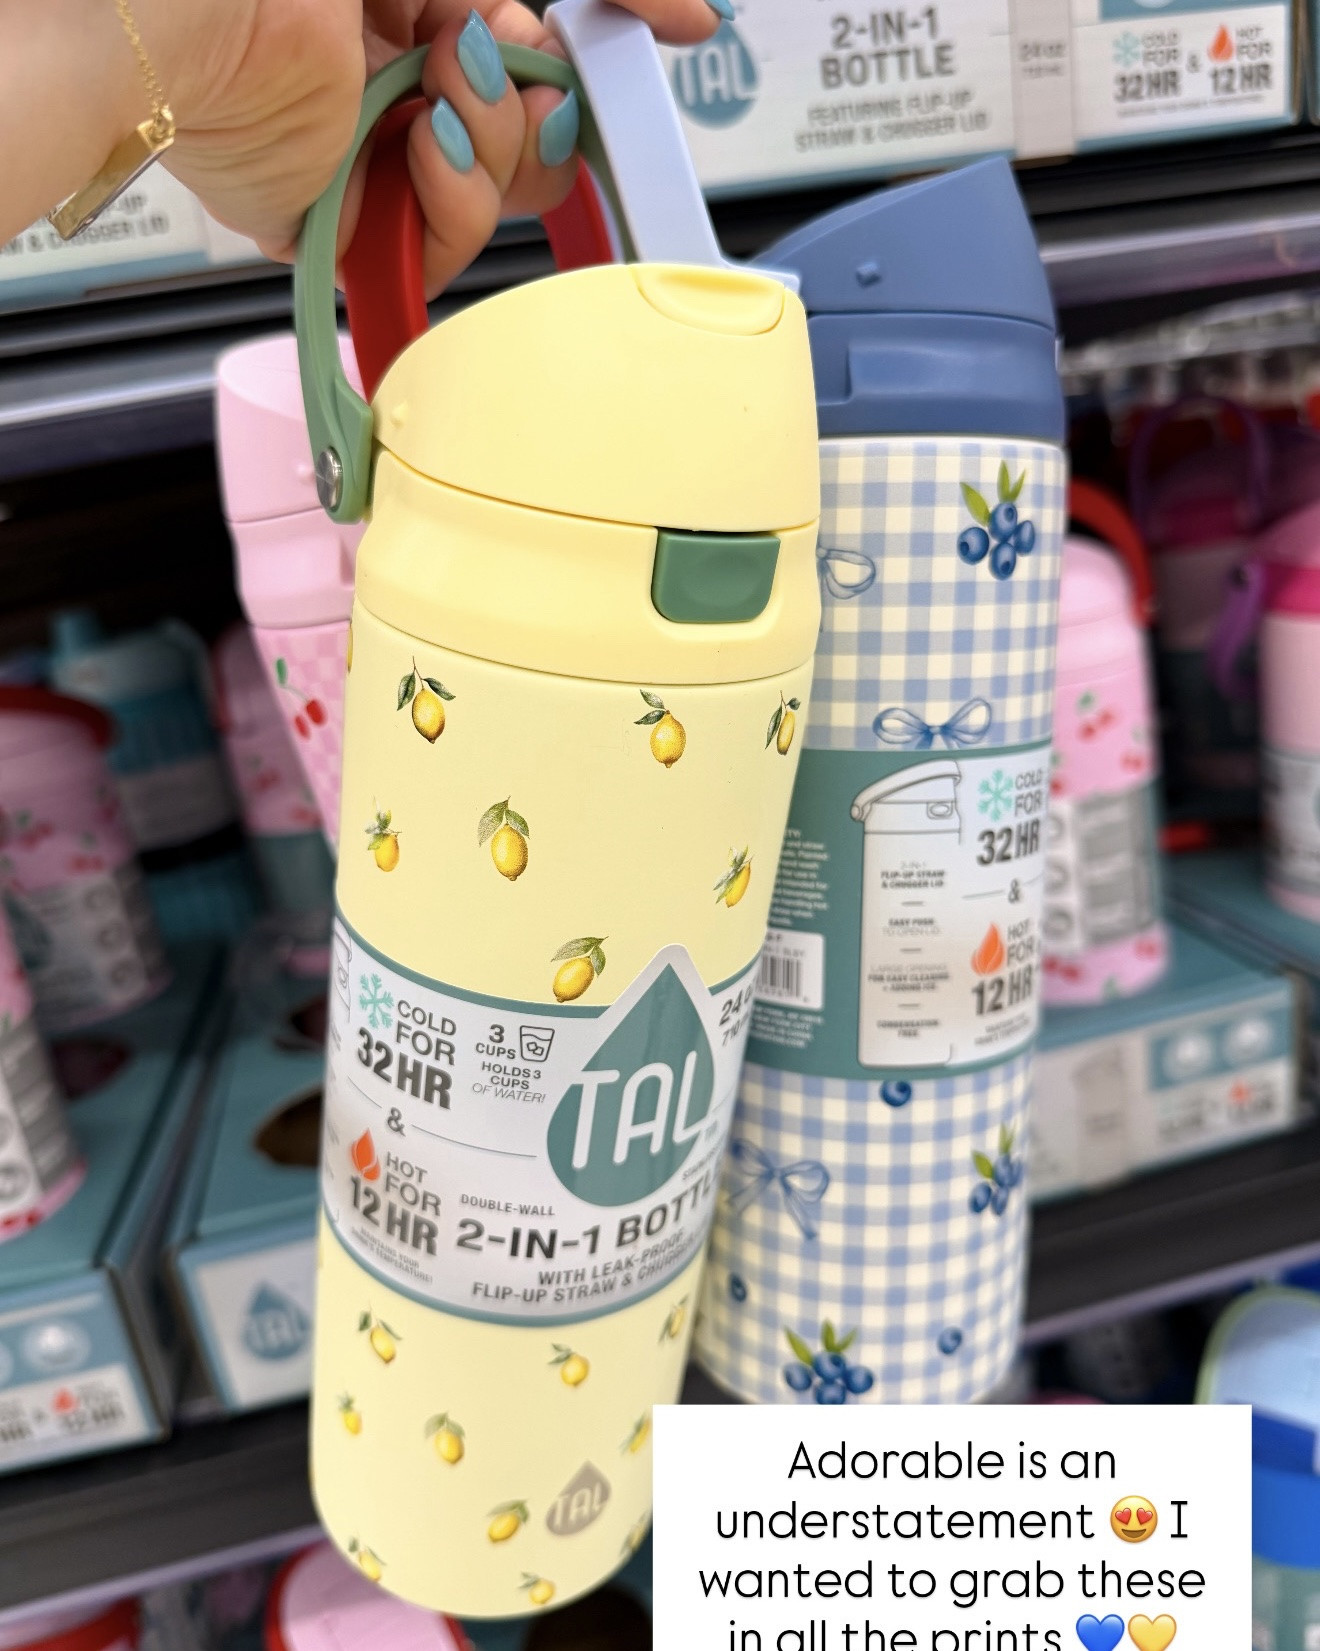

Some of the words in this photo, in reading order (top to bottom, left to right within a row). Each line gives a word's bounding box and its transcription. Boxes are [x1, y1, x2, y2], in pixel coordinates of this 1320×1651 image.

[831, 7, 940, 50] 2-IN-1
[1142, 30, 1181, 49] COLD
[819, 42, 956, 90] BOTTLE
[1143, 48, 1181, 69] FOR
[1236, 41, 1274, 63] FOR
[671, 41, 757, 107] TAL
[1113, 73, 1144, 103] 32
[1145, 68, 1182, 101] HR
[1209, 66, 1236, 96] 12
[1239, 62, 1273, 93] HR
[1014, 769, 1042, 791] COLD
[1014, 790, 1042, 817] FOR
[976, 827, 1012, 866] 32
[1014, 818, 1040, 860] HR
[1008, 879, 1020, 903] &
[1007, 918, 1029, 940] HOT
[1007, 936, 1034, 967] FOR
[971, 977, 1005, 1016] 12
[1007, 964, 1032, 1006] HR
[397, 999, 457, 1037] COLD
[719, 989, 742, 1027] 24
[396, 1020, 456, 1066] FOR
[489, 1024, 505, 1043] 3
[475, 1042, 516, 1060] CUPS
[357, 1027, 394, 1084] 32
[396, 1051, 453, 1110] HR
[481, 1061, 531, 1079] HOLDS
[533, 1069, 542, 1080] 3
[490, 1075, 530, 1090] CUPS
[472, 1082, 493, 1096] OF
[494, 1084, 548, 1104] WATER!
[568, 1049, 710, 1170] TAL
[386, 1106, 406, 1137] &
[386, 1151, 428, 1184] HOT
[385, 1172, 442, 1217] FOR
[460, 1193, 555, 1217] DOUBLE-WALL
[351, 1175, 381, 1227] 12
[386, 1201, 440, 1257] HR
[456, 1217, 600, 1259] 2-IN-1
[616, 1167, 714, 1248] BOTTL
[538, 1268, 587, 1286] WITH
[591, 1227, 684, 1279] LEAK-PROOF
[472, 1281, 548, 1302] FLIP-UP
[553, 1277, 616, 1302] STRAW
[621, 1272, 632, 1287] &
[552, 1481, 608, 1528] TAL
